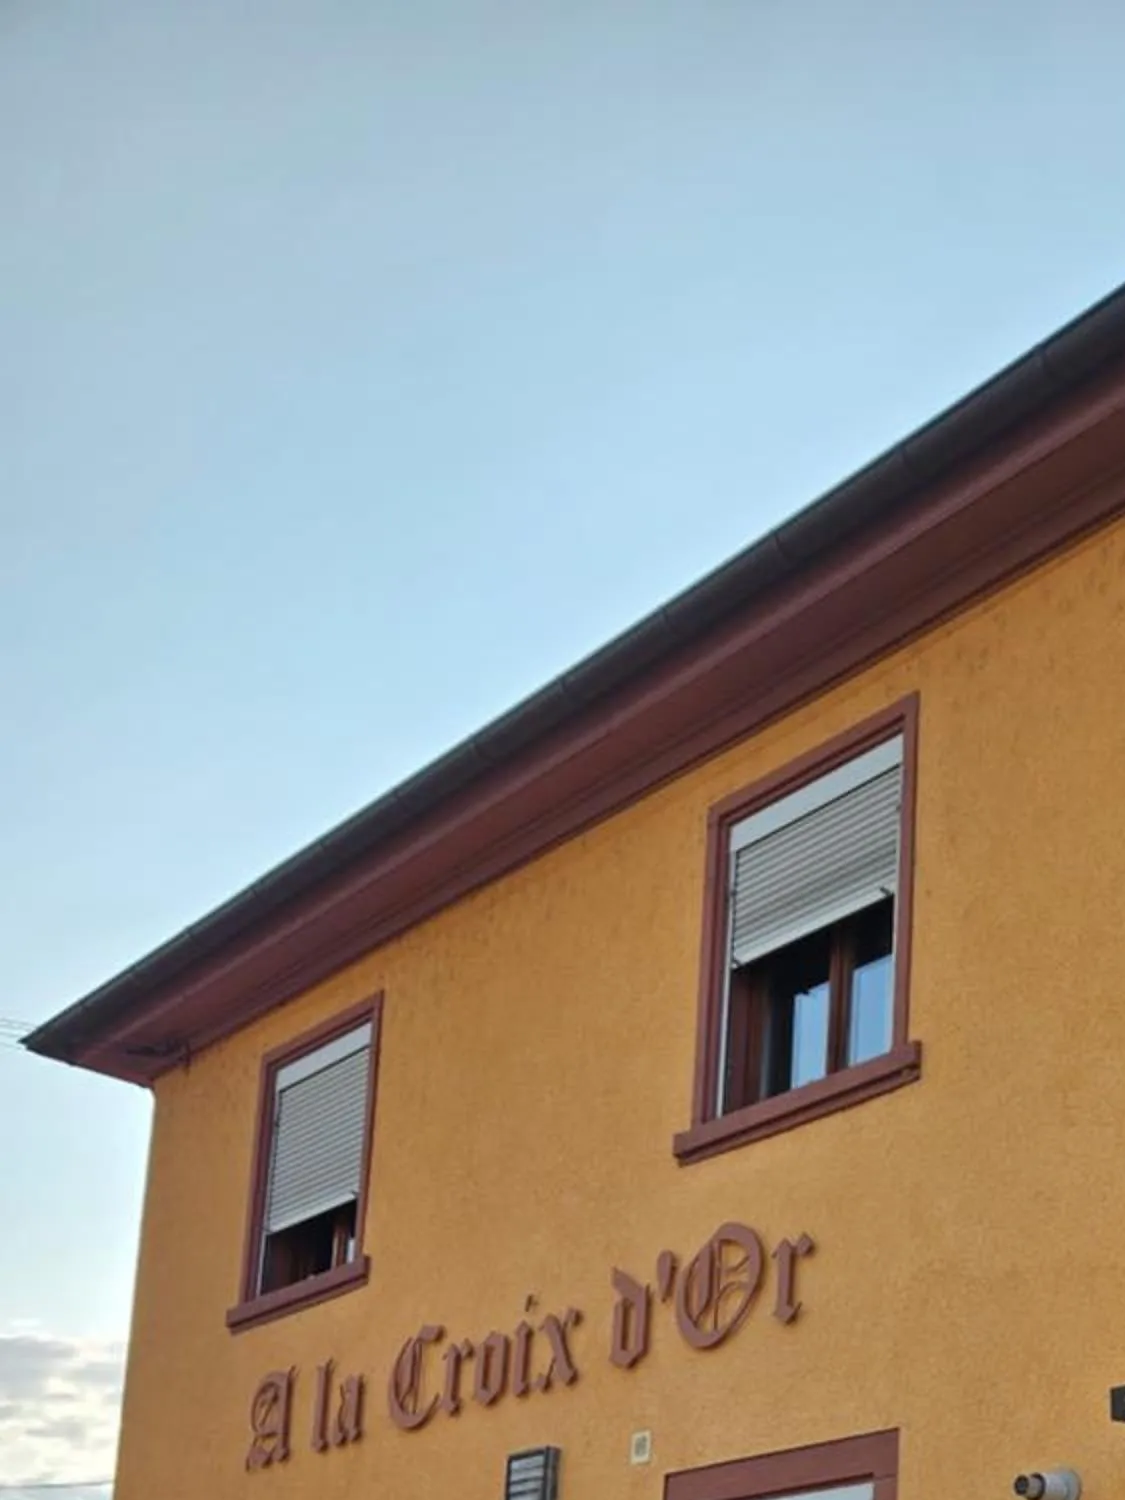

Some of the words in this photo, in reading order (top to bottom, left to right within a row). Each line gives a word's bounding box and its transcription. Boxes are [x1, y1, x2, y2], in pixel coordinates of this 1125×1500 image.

[246, 1364, 297, 1471] A
[311, 1357, 367, 1453] la
[386, 1293, 583, 1430] Croix
[609, 1221, 815, 1369] d'Or
